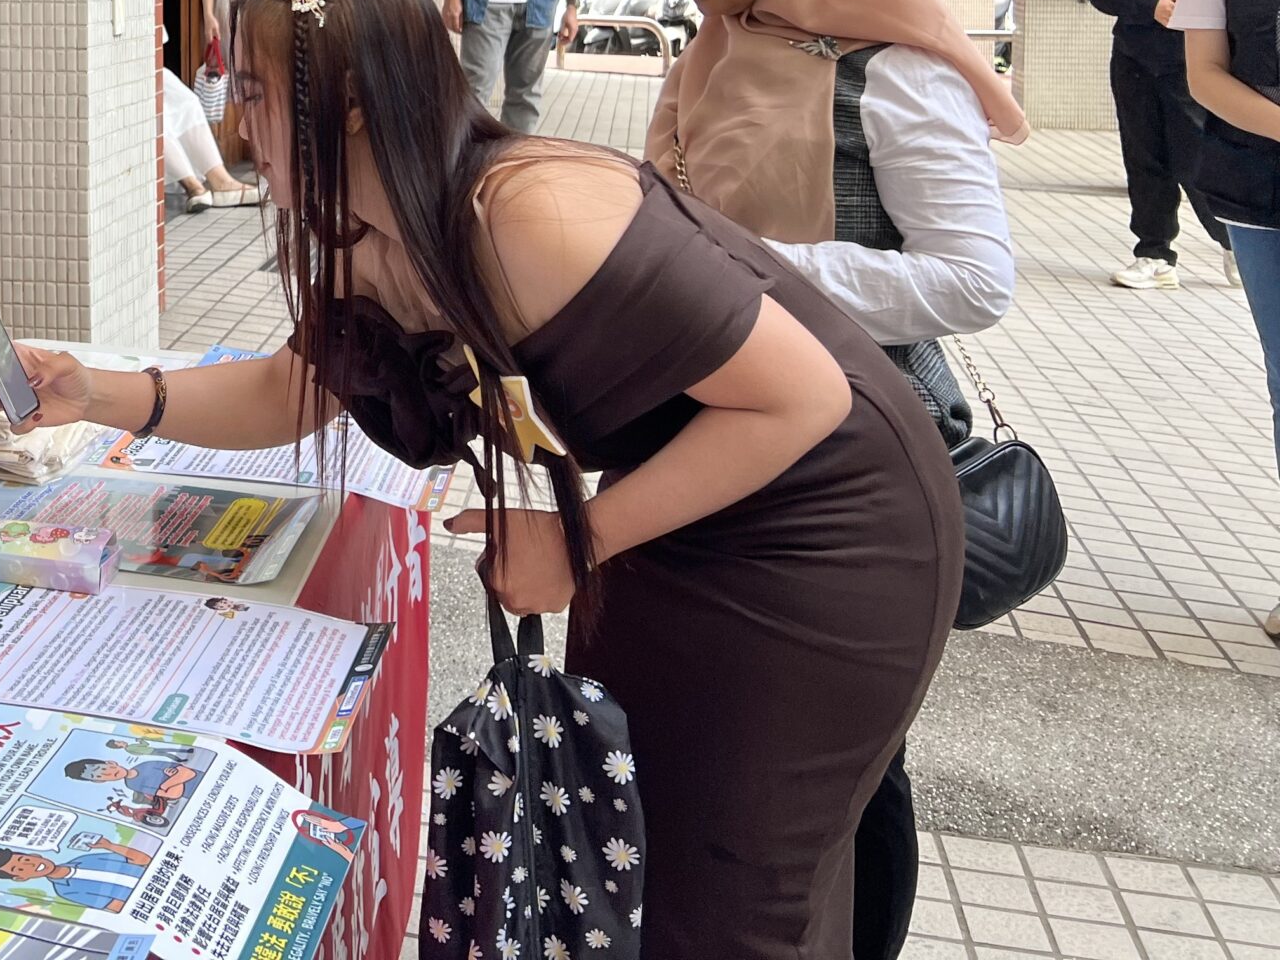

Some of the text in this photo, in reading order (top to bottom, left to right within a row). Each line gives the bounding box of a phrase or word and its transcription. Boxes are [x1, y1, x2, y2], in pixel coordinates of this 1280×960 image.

[0, 748, 19, 763] YOUR
[10, 755, 28, 769] OWN
[5, 778, 23, 793] ONLY
[15, 766, 33, 780] LEAD
[26, 759, 39, 767] TO
[288, 931, 310, 960] EGALITY.
[301, 901, 322, 928] BRAVELY
[313, 888, 327, 901] SAY
